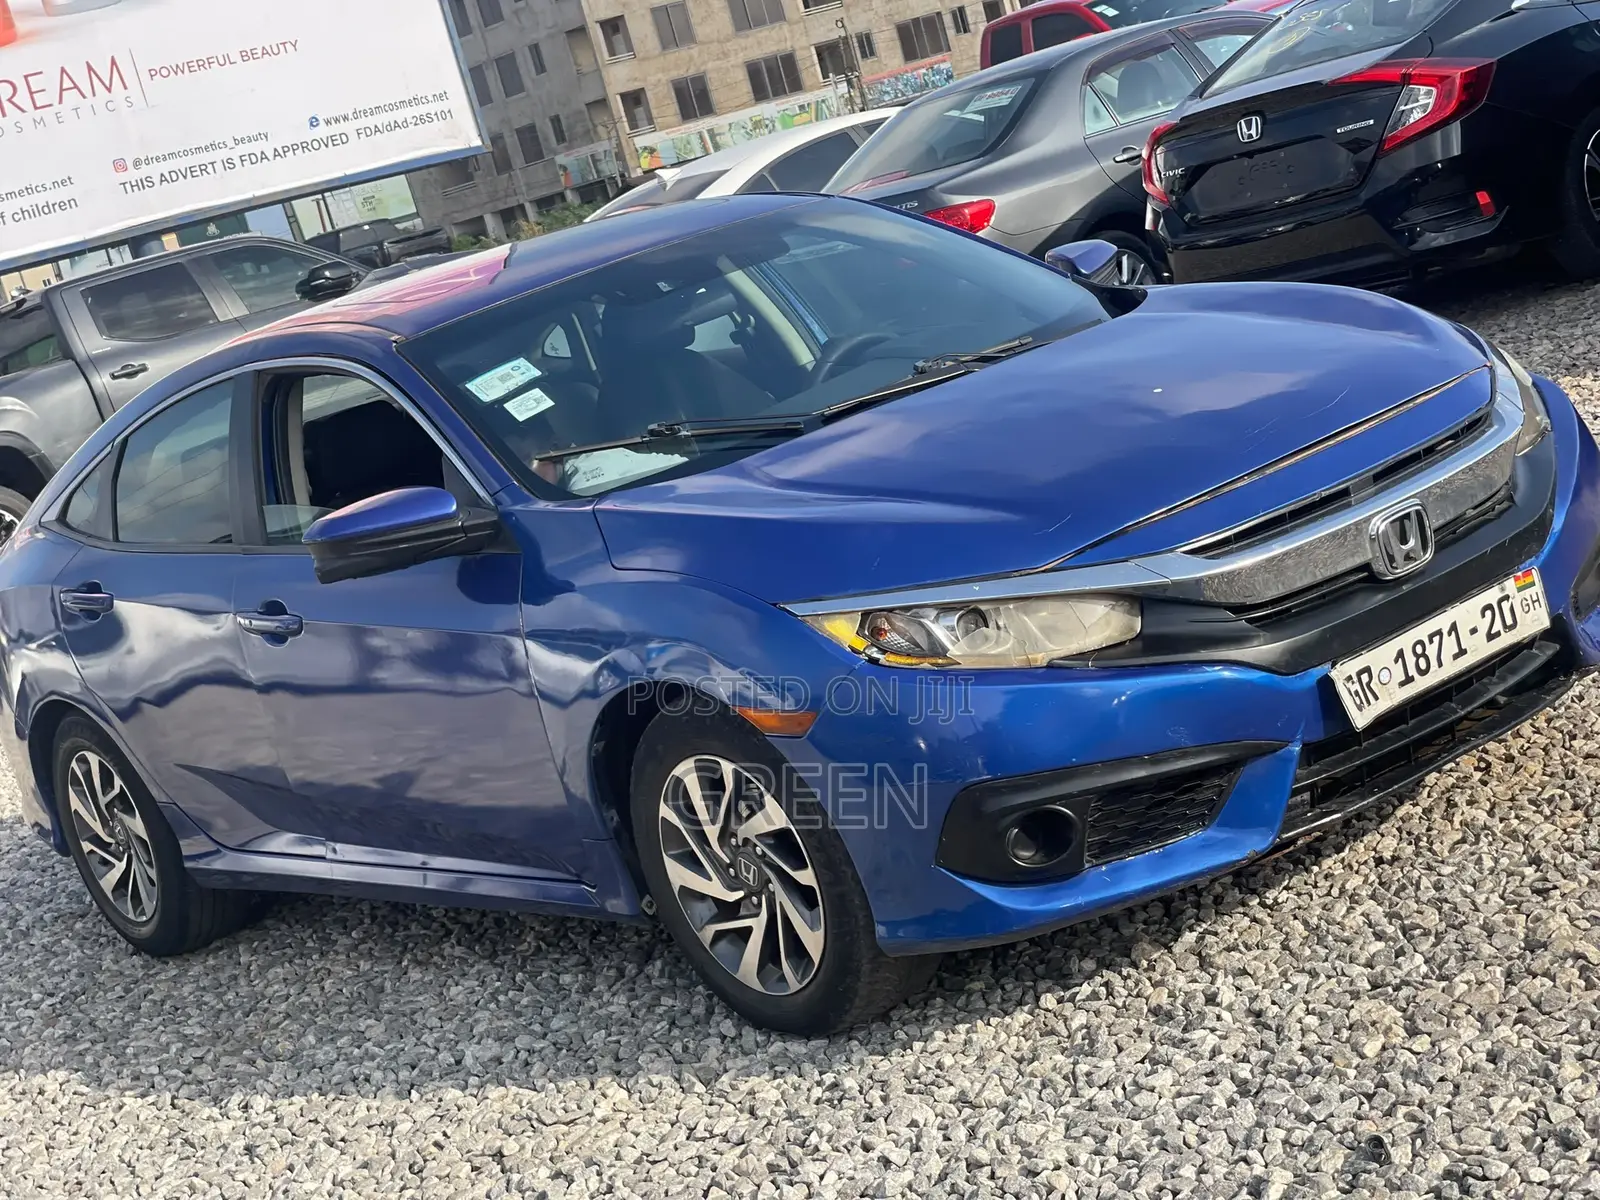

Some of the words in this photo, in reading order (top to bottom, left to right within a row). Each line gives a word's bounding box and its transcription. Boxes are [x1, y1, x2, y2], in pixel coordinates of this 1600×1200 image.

[148, 53, 237, 81] POWERFUL
[239, 39, 299, 62] BEAUTY
[0, 55, 128, 118] REAM
[323, 90, 450, 127] www.dreamcosmetics.net
[119, 175, 155, 195] THIS
[159, 161, 219, 186] ADVERT
[221, 157, 236, 172] IS
[239, 150, 271, 168] FDA
[273, 132, 350, 161] APPROVED
[356, 108, 454, 140] FDA/dAd-26S101
[132, 131, 270, 171] @dreamcosmetics_beauty
[1161, 167, 1185, 178] CIVIC
[11, 197, 79, 223] children
[1520, 591, 1543, 614] GH
[1343, 664, 1380, 713] GR
[1393, 593, 1518, 689] 1871-20
